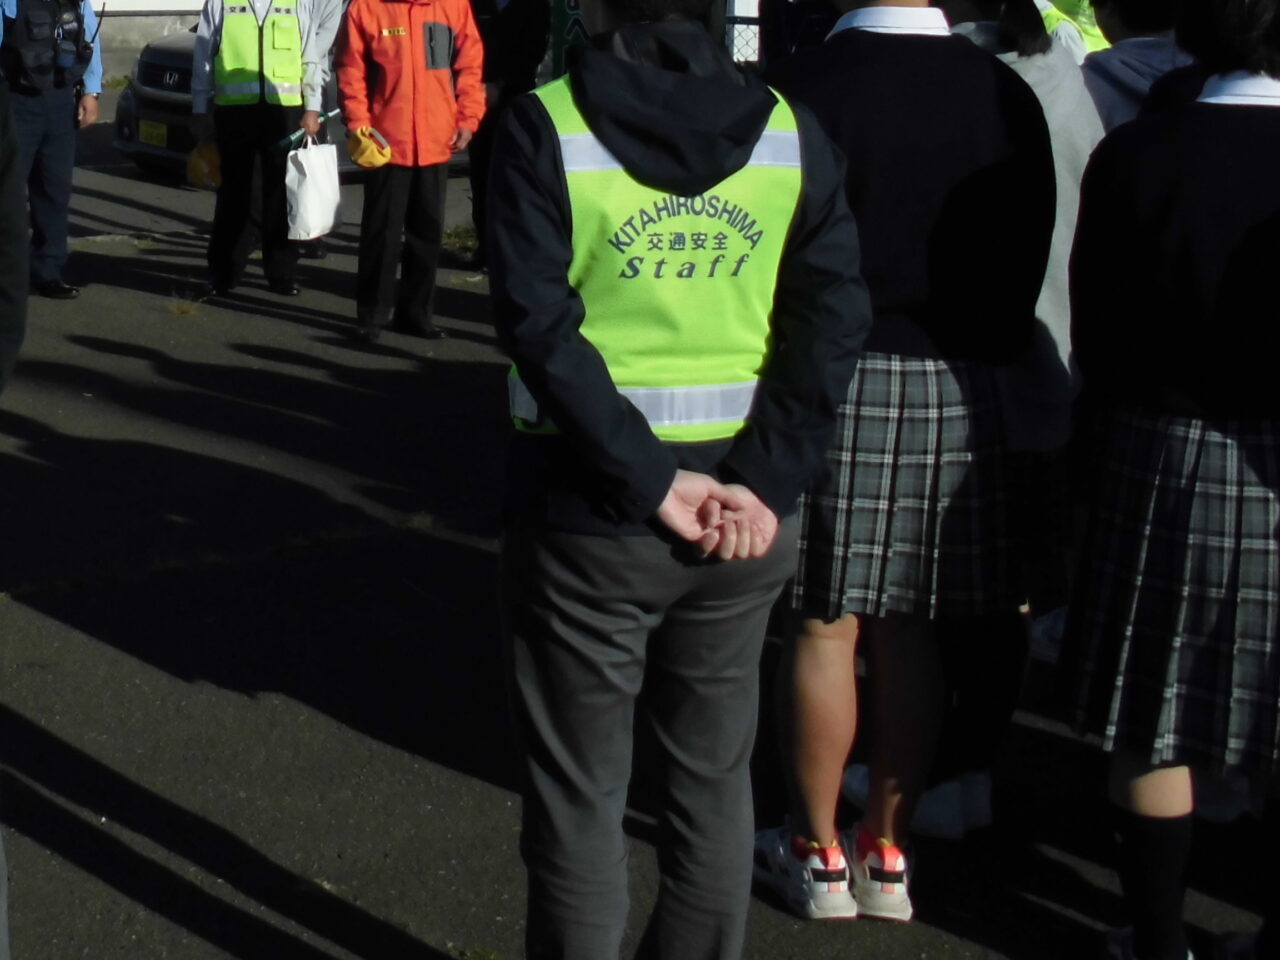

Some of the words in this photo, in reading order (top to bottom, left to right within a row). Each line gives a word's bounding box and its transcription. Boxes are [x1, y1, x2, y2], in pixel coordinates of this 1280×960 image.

[608, 194, 764, 254] KITAHIROSHIMA
[647, 231, 729, 252] 交通安全
[619, 253, 750, 279] Staff
